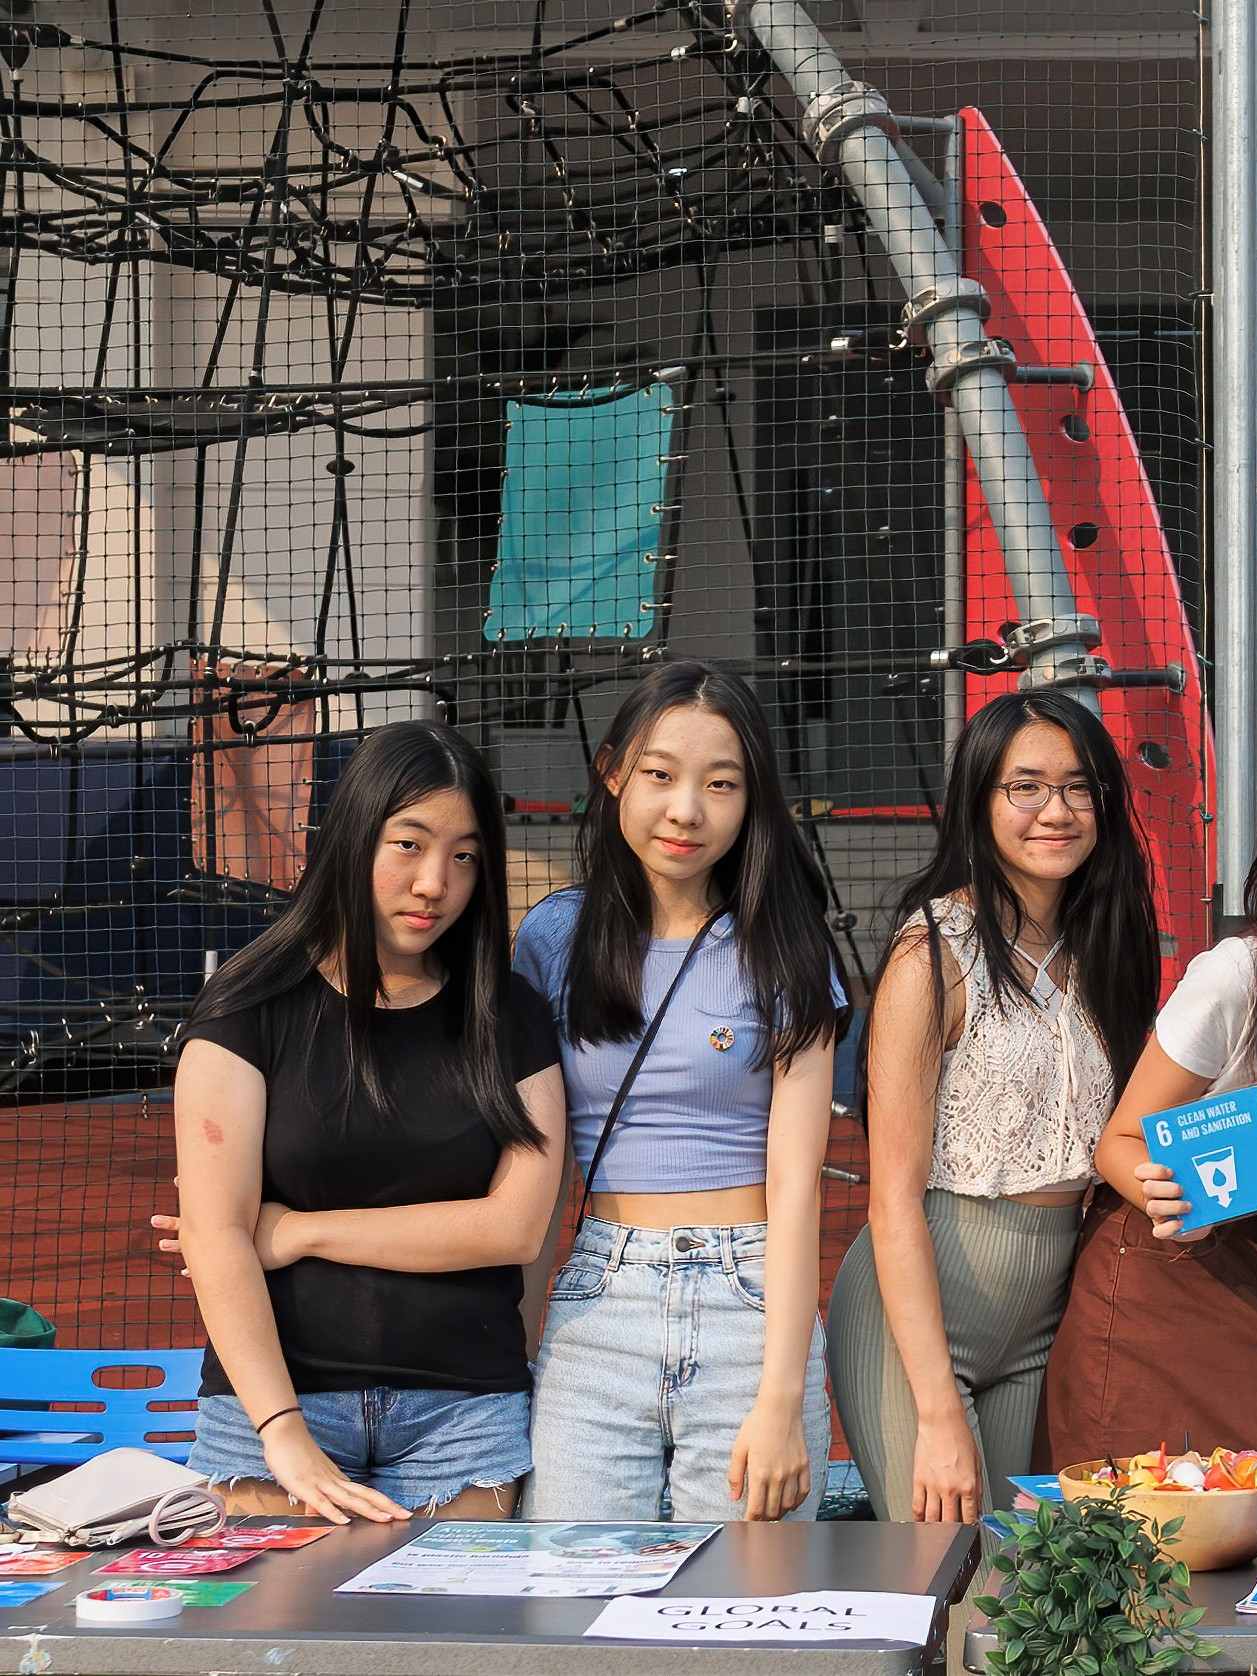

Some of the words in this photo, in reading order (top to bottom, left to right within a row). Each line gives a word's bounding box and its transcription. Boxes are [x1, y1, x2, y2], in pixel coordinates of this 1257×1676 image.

[1177, 1109, 1206, 1127] CLEAN
[1206, 1101, 1237, 1119] WATER
[1182, 1126, 1201, 1141] AND
[1201, 1112, 1252, 1135] SANITATION
[1156, 1120, 1173, 1147] 6
[671, 1618, 854, 1631] GOALS
